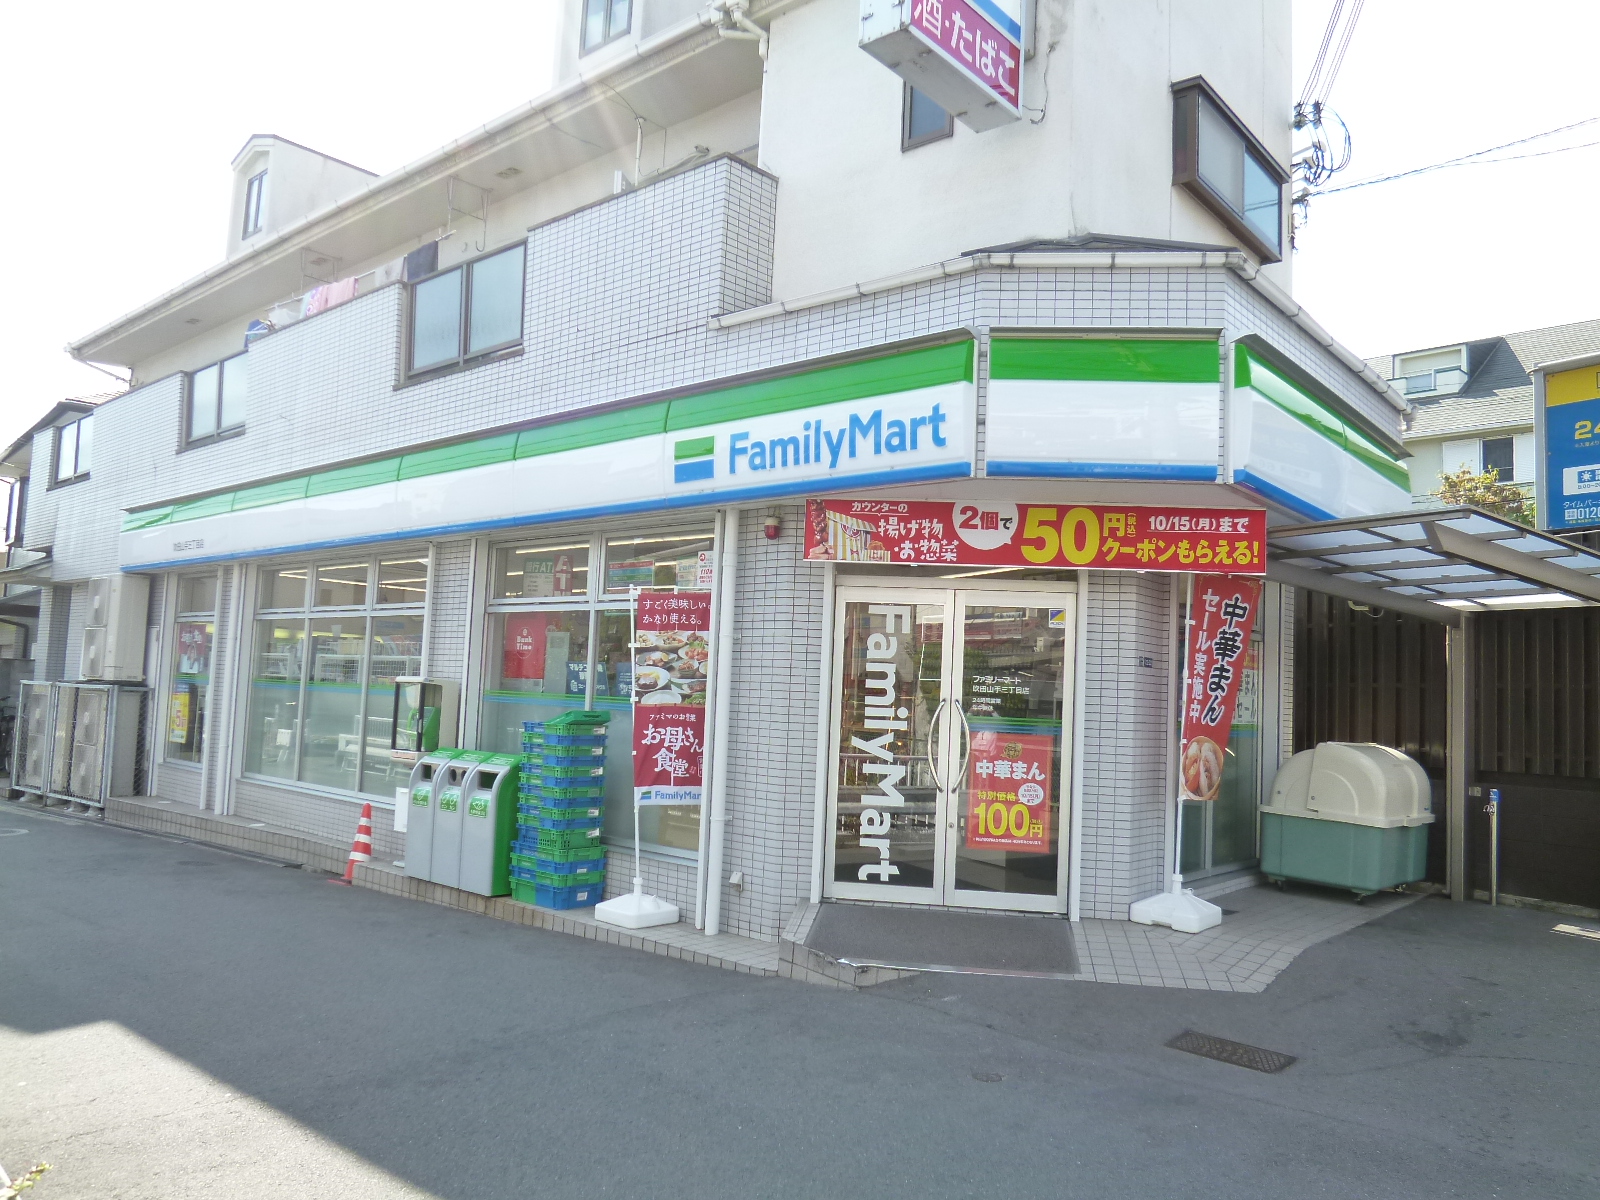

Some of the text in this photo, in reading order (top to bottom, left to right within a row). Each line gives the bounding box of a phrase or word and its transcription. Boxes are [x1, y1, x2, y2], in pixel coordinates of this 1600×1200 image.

[728, 402, 948, 476] FamilyMart
[851, 501, 909, 513] カウンターの
[1562, 499, 1600, 509] タイムパー
[878, 516, 944, 540] 揚げ物
[958, 505, 1013, 531] 2個で
[1102, 537, 1259, 565] クーポンもらえる!
[642, 598, 711, 610] すごく美味しい。
[642, 613, 702, 625] かなり使える。
[1189, 587, 1220, 724] セール実施中
[1201, 595, 1249, 726] 中華まん
[972, 675, 1022, 685] ファミリーマート
[972, 685, 1030, 695] 吹田山手三丁目店
[641, 723, 704, 751] お母さん
[851, 603, 911, 882] FamilyMart
[651, 747, 690, 777] 食堂
[975, 759, 1046, 781] 中華まん
[654, 790, 702, 801] FamilyMar
